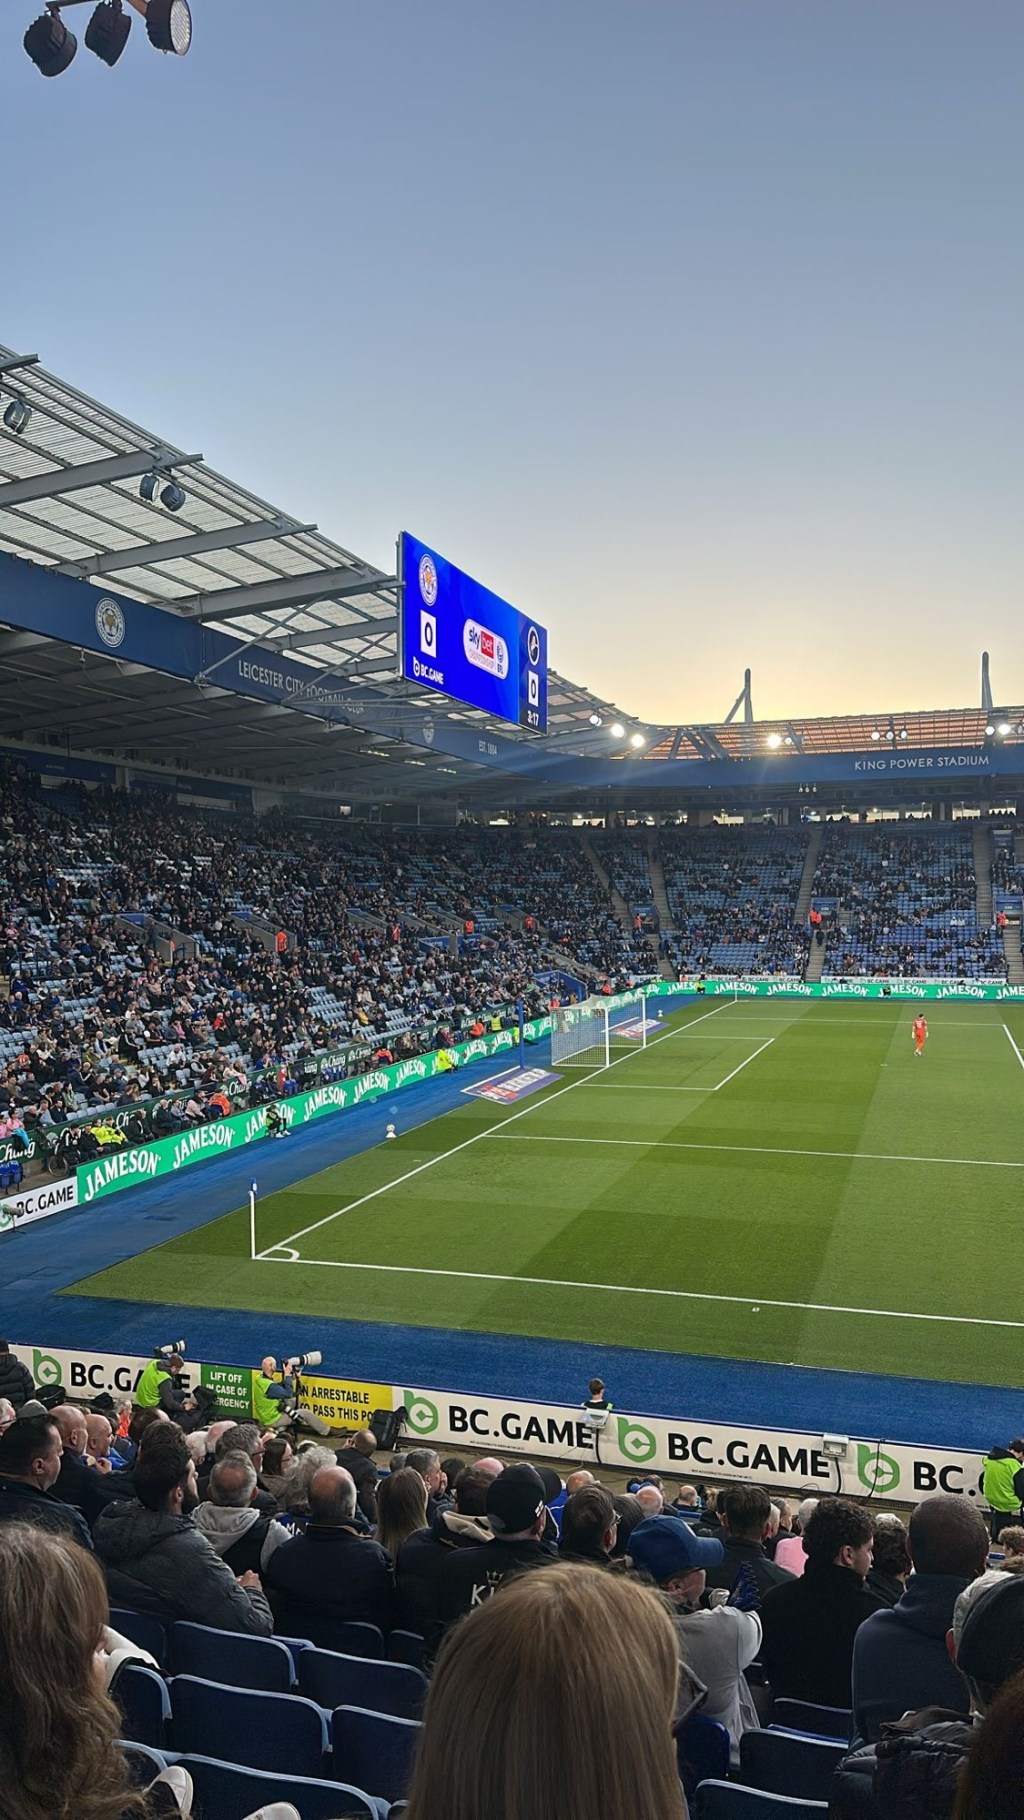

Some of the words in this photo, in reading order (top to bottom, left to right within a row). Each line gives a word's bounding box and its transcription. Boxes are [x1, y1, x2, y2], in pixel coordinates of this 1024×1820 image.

[424, 621, 434, 647] 0
[238, 659, 284, 689] LEICESTER
[285, 675, 305, 696] CITY
[530, 679, 537, 699] 0
[854, 760, 886, 771] KING
[890, 757, 933, 769] POWER
[937, 755, 989, 767] STADIUM
[714, 982, 759, 995] JAMESON
[766, 982, 813, 996] JAMESON
[821, 983, 869, 997] JAMESON
[878, 984, 928, 998] JMESON
[936, 984, 987, 999] JAMESON
[396, 1060, 426, 1088] JAMESON
[353, 1071, 390, 1104] JAMESON
[304, 1086, 347, 1121] JAMESON
[173, 1124, 235, 1169] JAMESON
[85, 1150, 161, 1201] JAMESON
[16, 1185, 74, 1218] BC.GAME
[210, 1371, 227, 1383] LIFT
[228, 1373, 243, 1384] OFF
[215, 1384, 236, 1395] CASE
[236, 1386, 248, 1396] OF
[311, 1387, 370, 1404] ARRESTABLE
[312, 1404, 335, 1418] PASS
[338, 1407, 359, 1421] THIS
[449, 1406, 594, 1449] BC.GAME
[668, 1433, 830, 1478] BC.GAME
